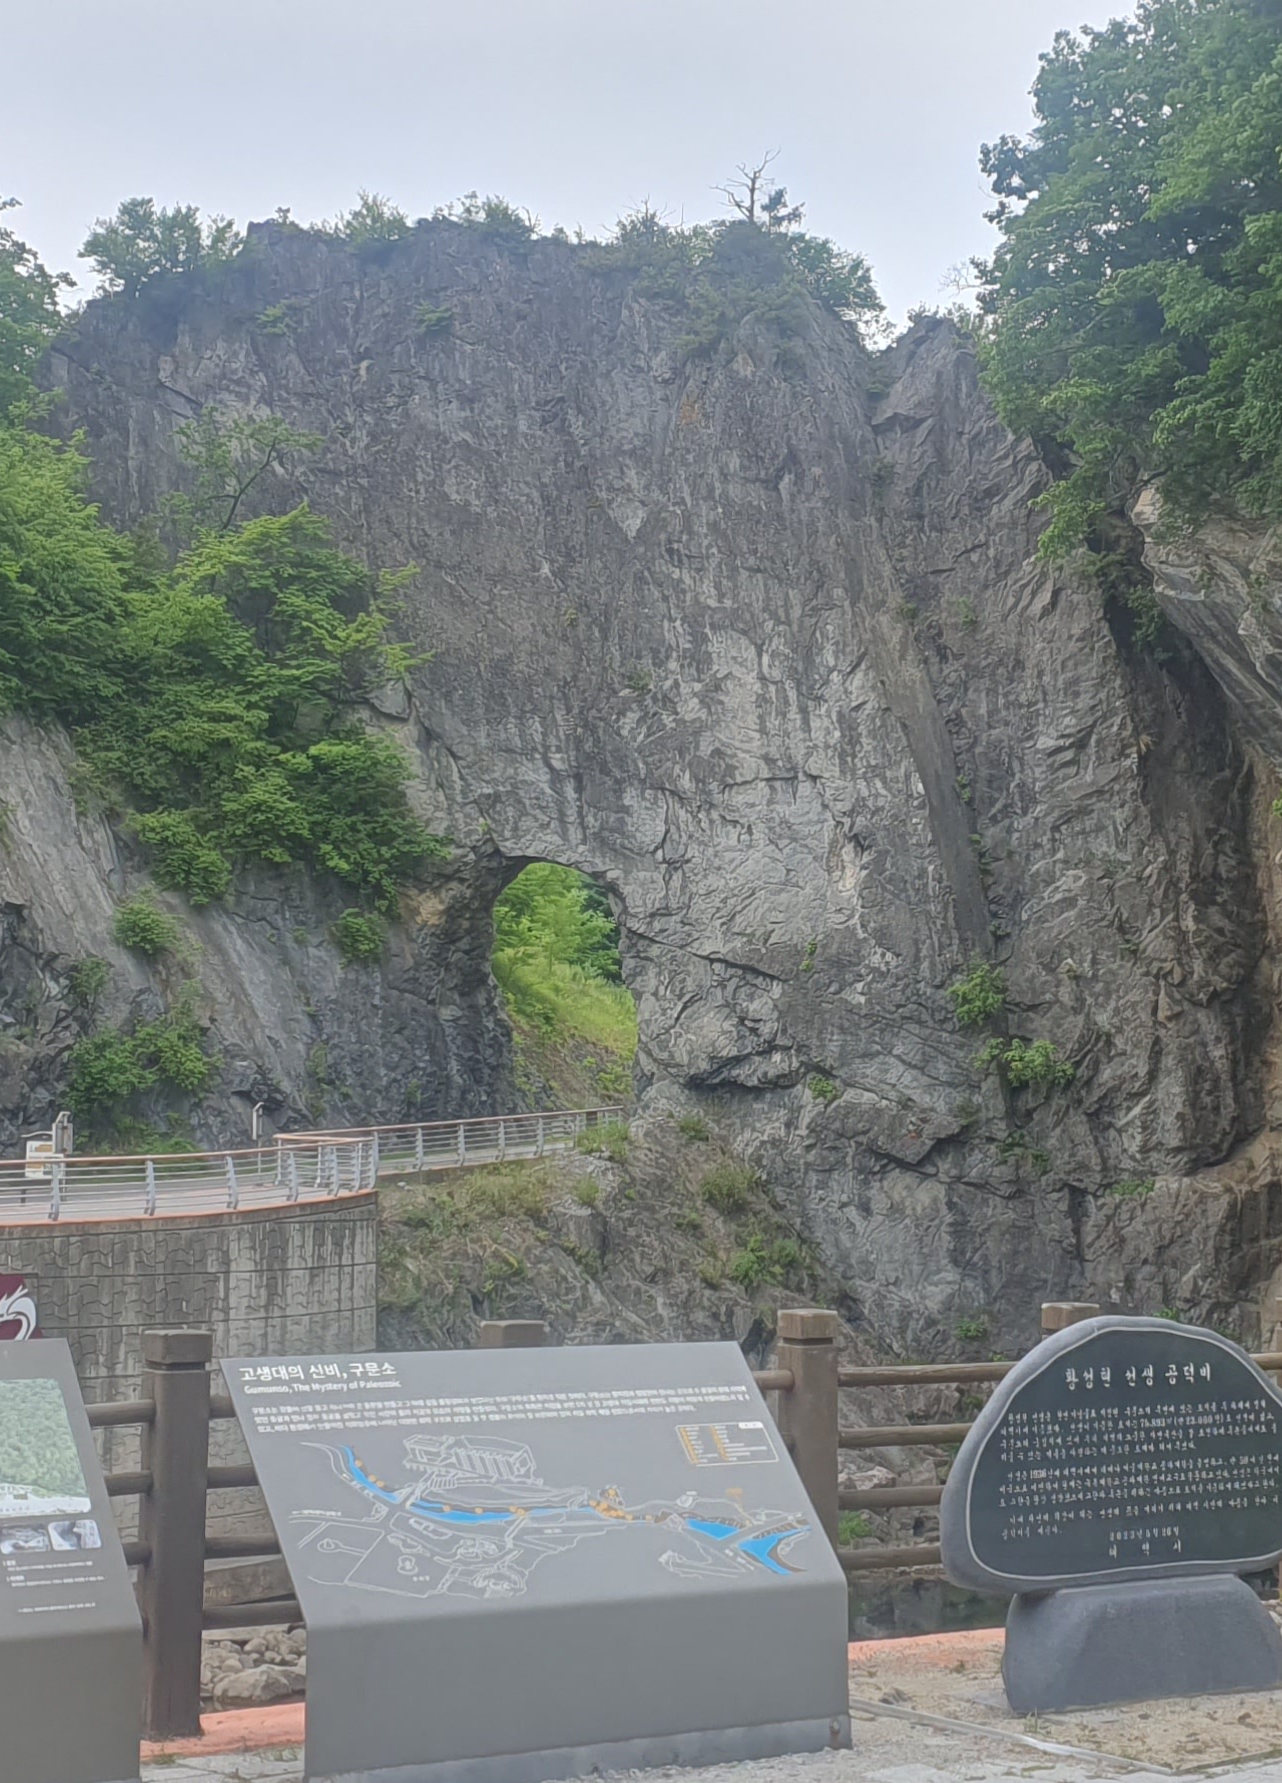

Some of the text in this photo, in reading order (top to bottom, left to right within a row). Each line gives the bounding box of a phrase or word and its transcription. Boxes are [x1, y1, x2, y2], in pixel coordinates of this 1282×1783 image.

[239, 1361, 397, 1382] 고생대의 신비, 구문소
[1125, 1366, 1154, 1387] 선생
[1165, 1362, 1211, 1385] 공덕비
[244, 1384, 293, 1395] Gumunso,
[293, 1383, 311, 1392] The
[311, 1381, 348, 1394] Mystery
